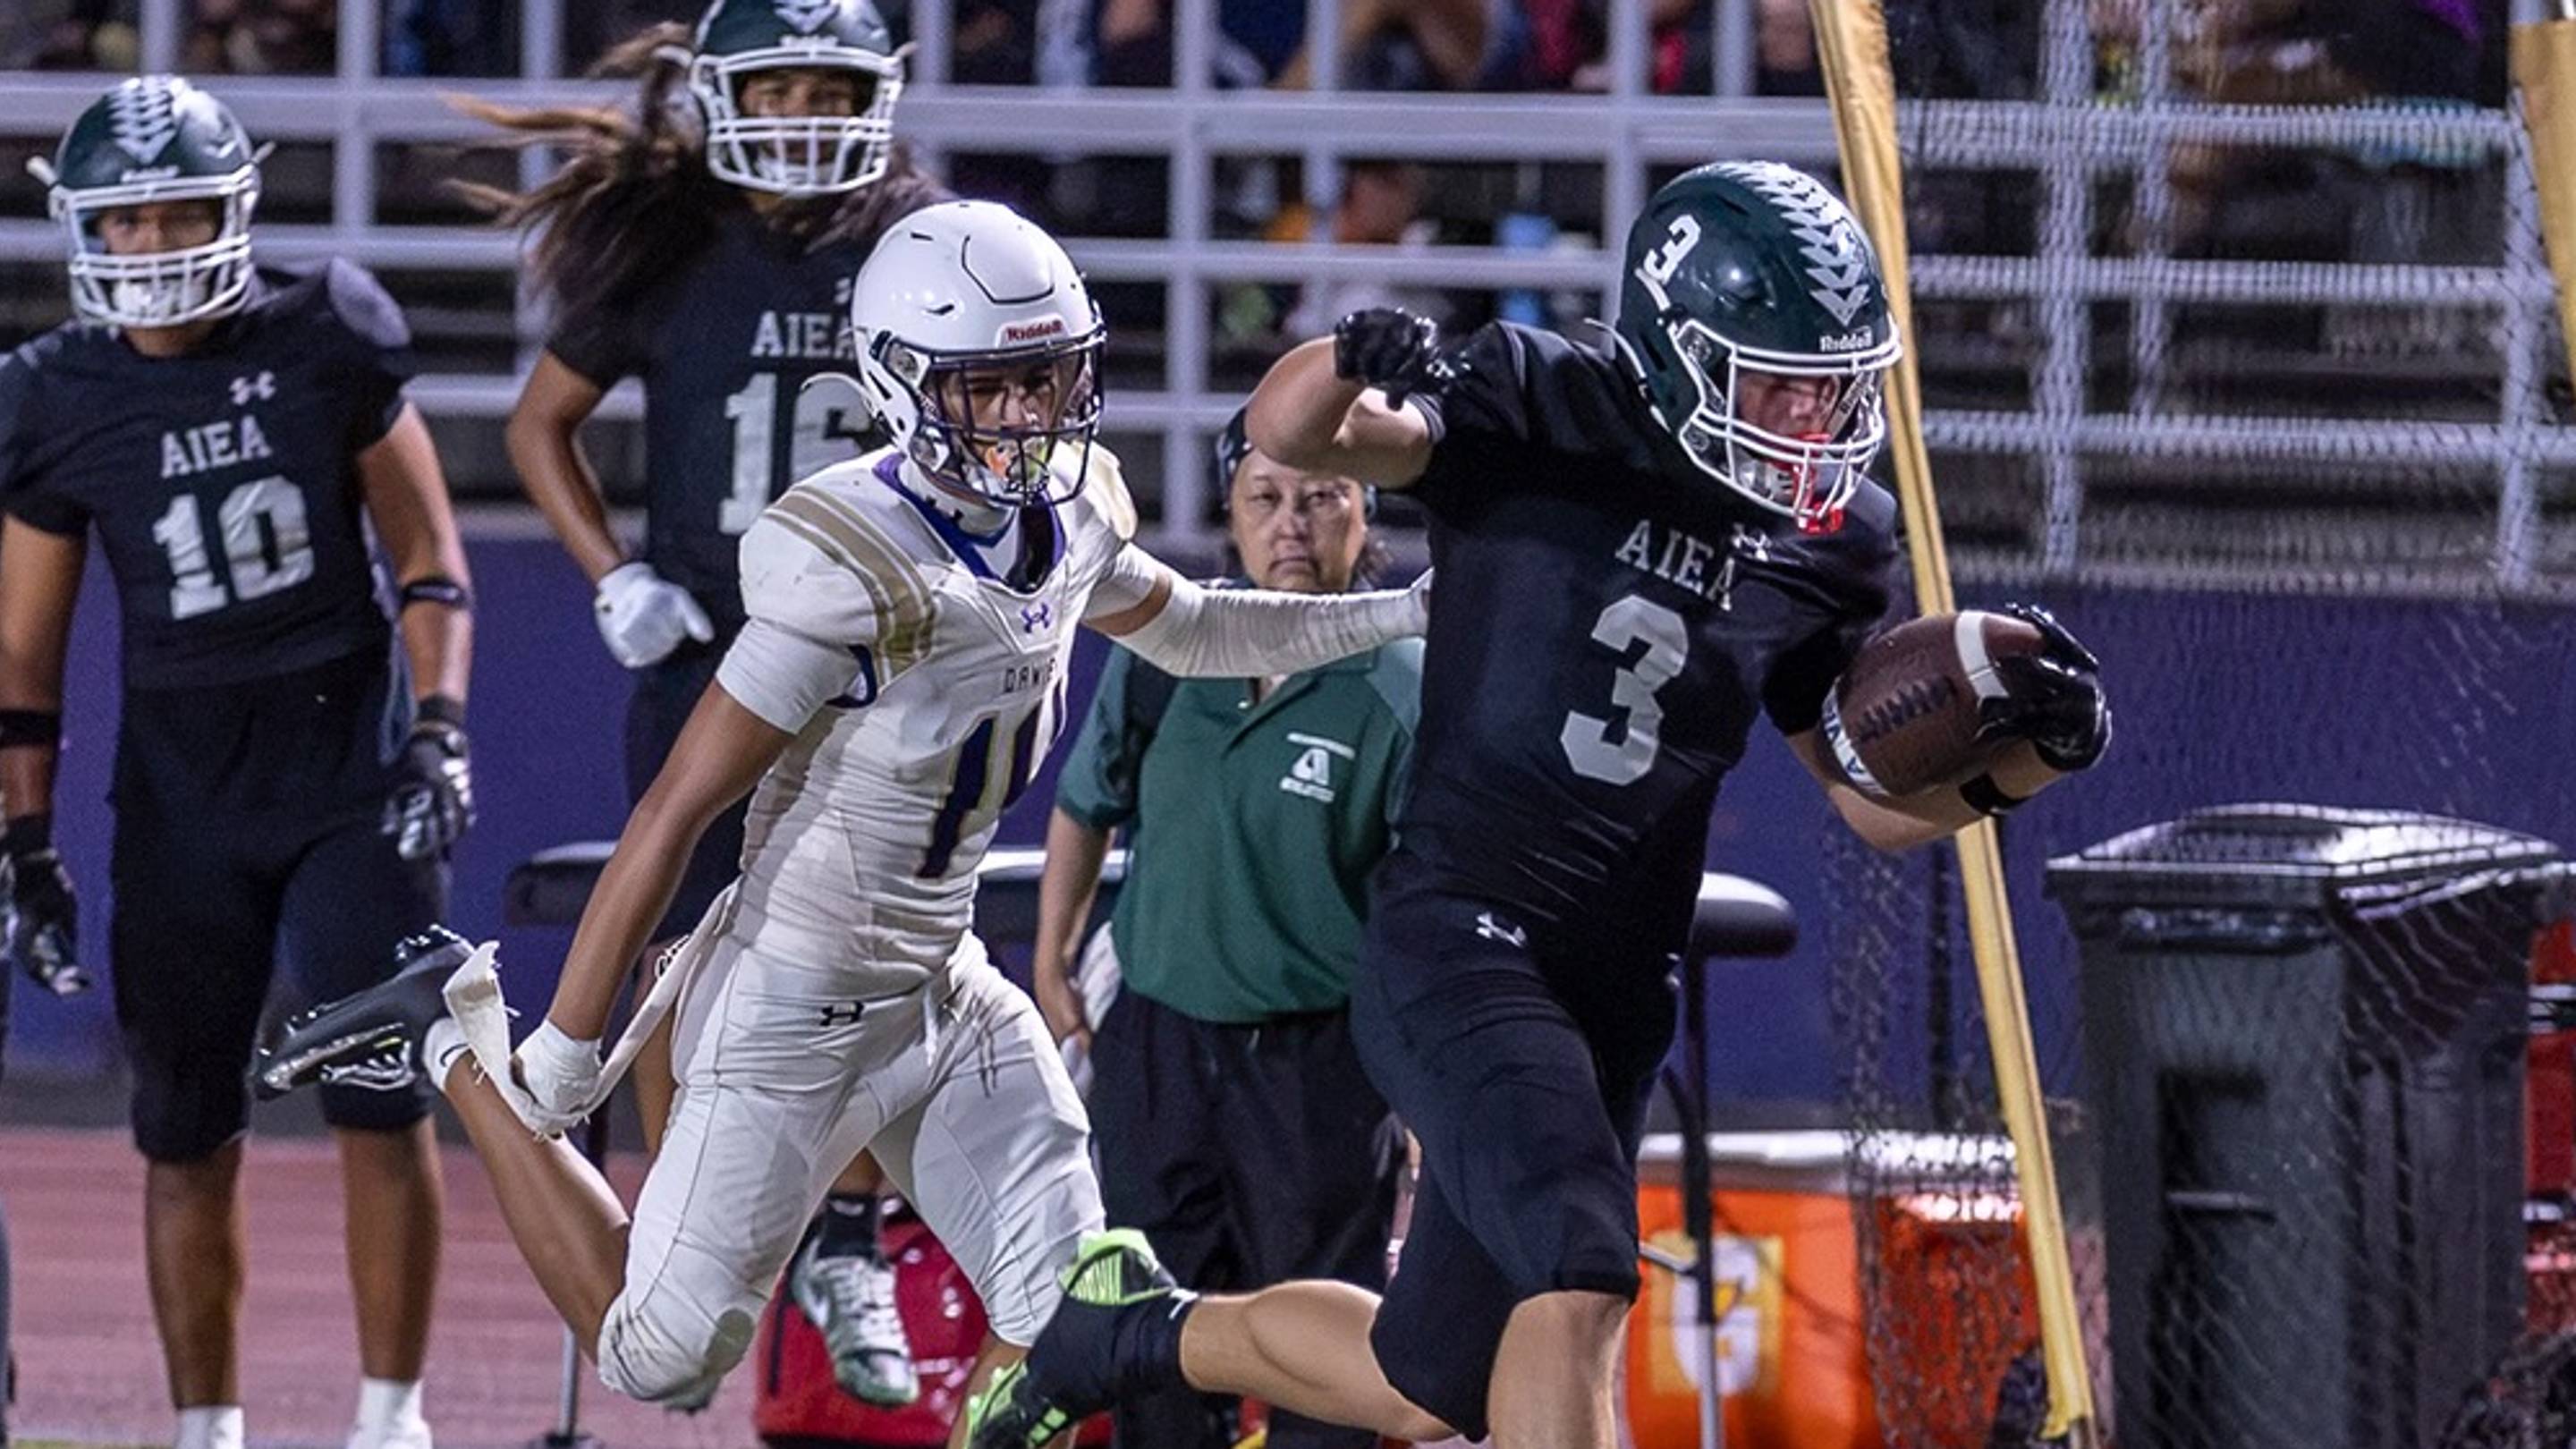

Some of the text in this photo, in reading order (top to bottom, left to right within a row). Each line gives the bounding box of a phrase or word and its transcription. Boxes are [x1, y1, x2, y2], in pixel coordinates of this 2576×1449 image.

[1644, 214, 1701, 284] 3
[160, 415, 273, 479] AIEA
[152, 474, 315, 620] 10
[1614, 519, 1735, 611] AIEA
[1560, 594, 1690, 786] 3
